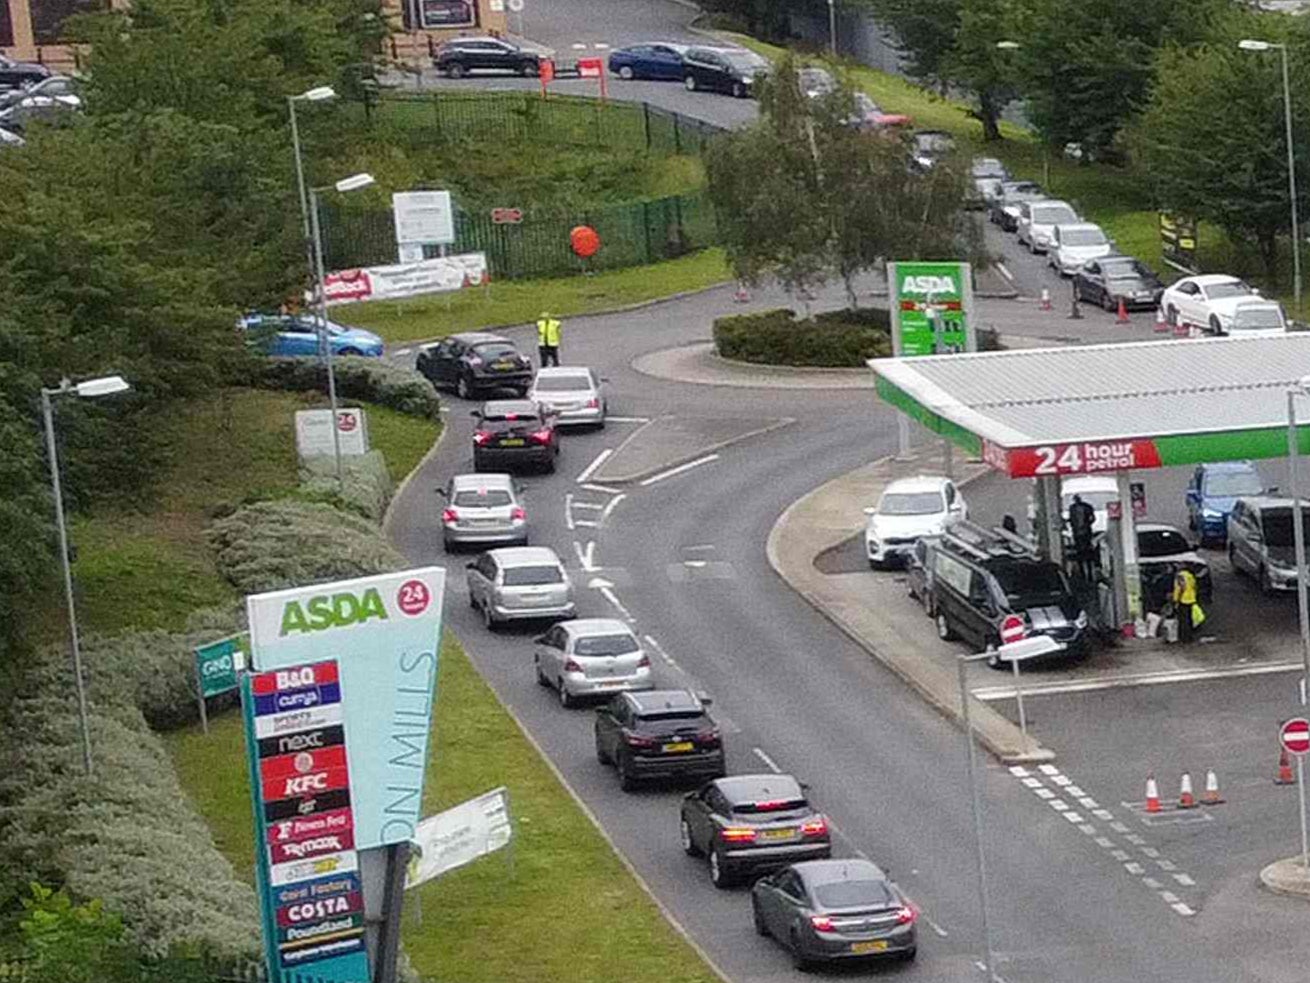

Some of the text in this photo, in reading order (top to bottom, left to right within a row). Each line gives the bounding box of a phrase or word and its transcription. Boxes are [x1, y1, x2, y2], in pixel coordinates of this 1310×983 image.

[902, 275, 956, 293] ASDA
[1035, 446, 1082, 474] 24
[1085, 443, 1133, 459] hour
[1085, 454, 1135, 472] petrol
[402, 585, 424, 602] 24
[280, 587, 388, 637] ASDA
[276, 667, 315, 690] B&Q
[388, 651, 435, 768] MILLS
[279, 731, 324, 752] next
[284, 772, 328, 795] KFC
[288, 896, 350, 921] COSTA
[287, 917, 353, 940] Poundland
